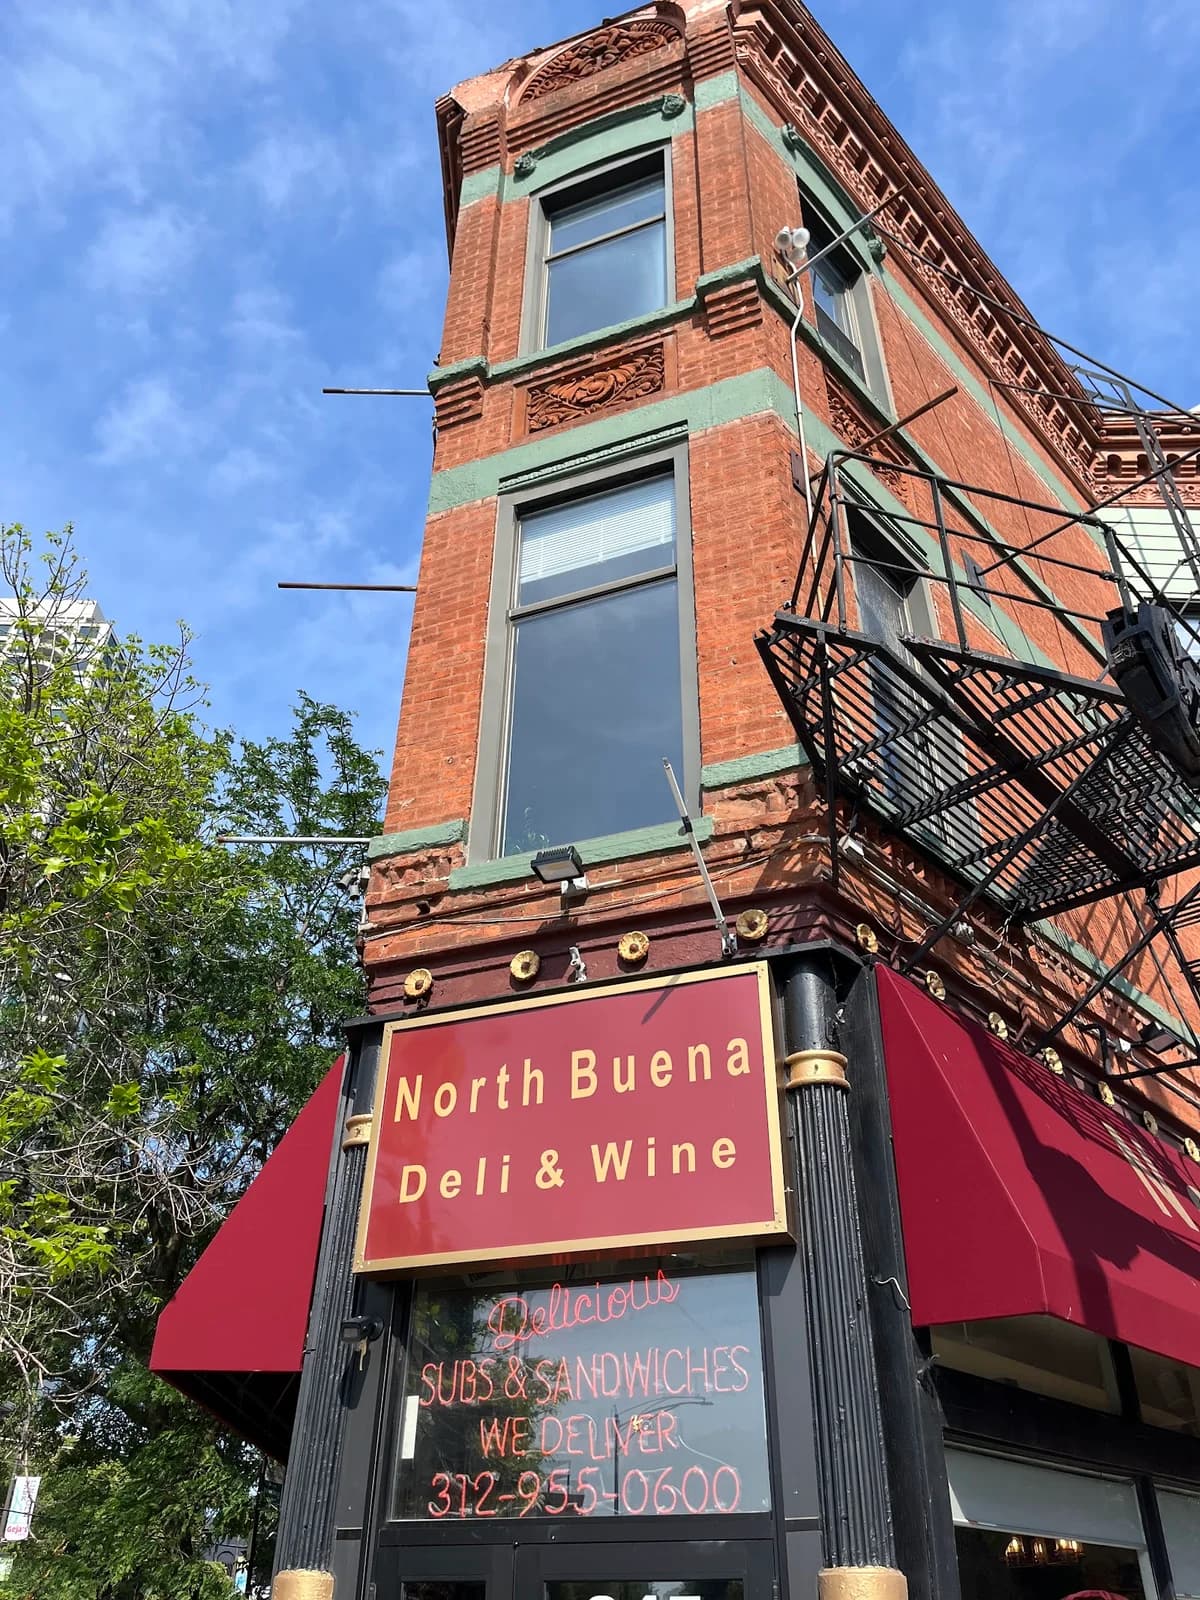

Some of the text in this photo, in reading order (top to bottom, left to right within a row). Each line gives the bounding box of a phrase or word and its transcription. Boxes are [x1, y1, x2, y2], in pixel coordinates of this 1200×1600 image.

[394, 1037, 751, 1123] North Buena
[399, 1136, 737, 1204] Deli & Wine
[487, 1269, 680, 1350] Delicious
[420, 1345, 751, 1407] SUBS & SANDWICHES
[480, 1410, 678, 1461] WE DELIVER
[427, 1466, 742, 1519] 312-955-0600
